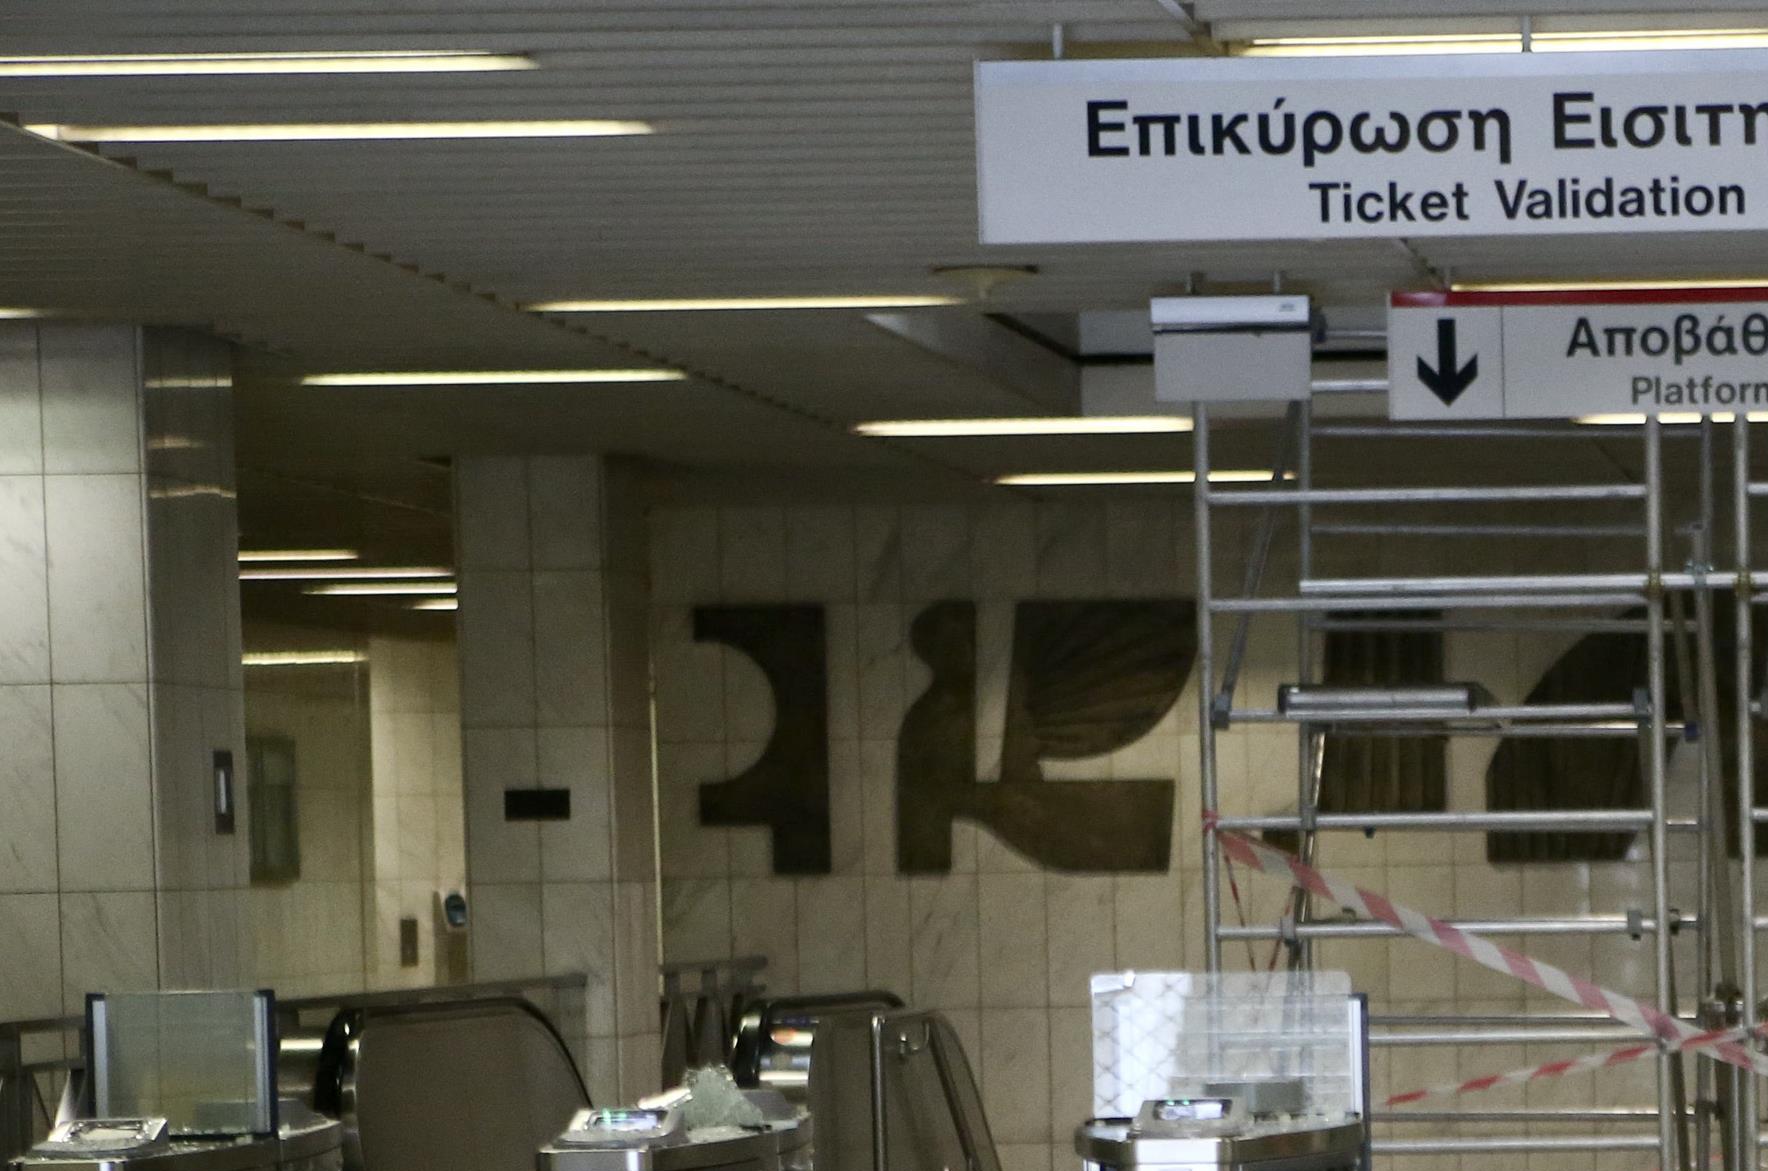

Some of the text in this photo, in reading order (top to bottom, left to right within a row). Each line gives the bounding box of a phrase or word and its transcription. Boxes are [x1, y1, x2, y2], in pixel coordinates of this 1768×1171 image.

[1086, 97, 1512, 168] Επικύρωση
[1308, 175, 1747, 224] Ticket Validation
